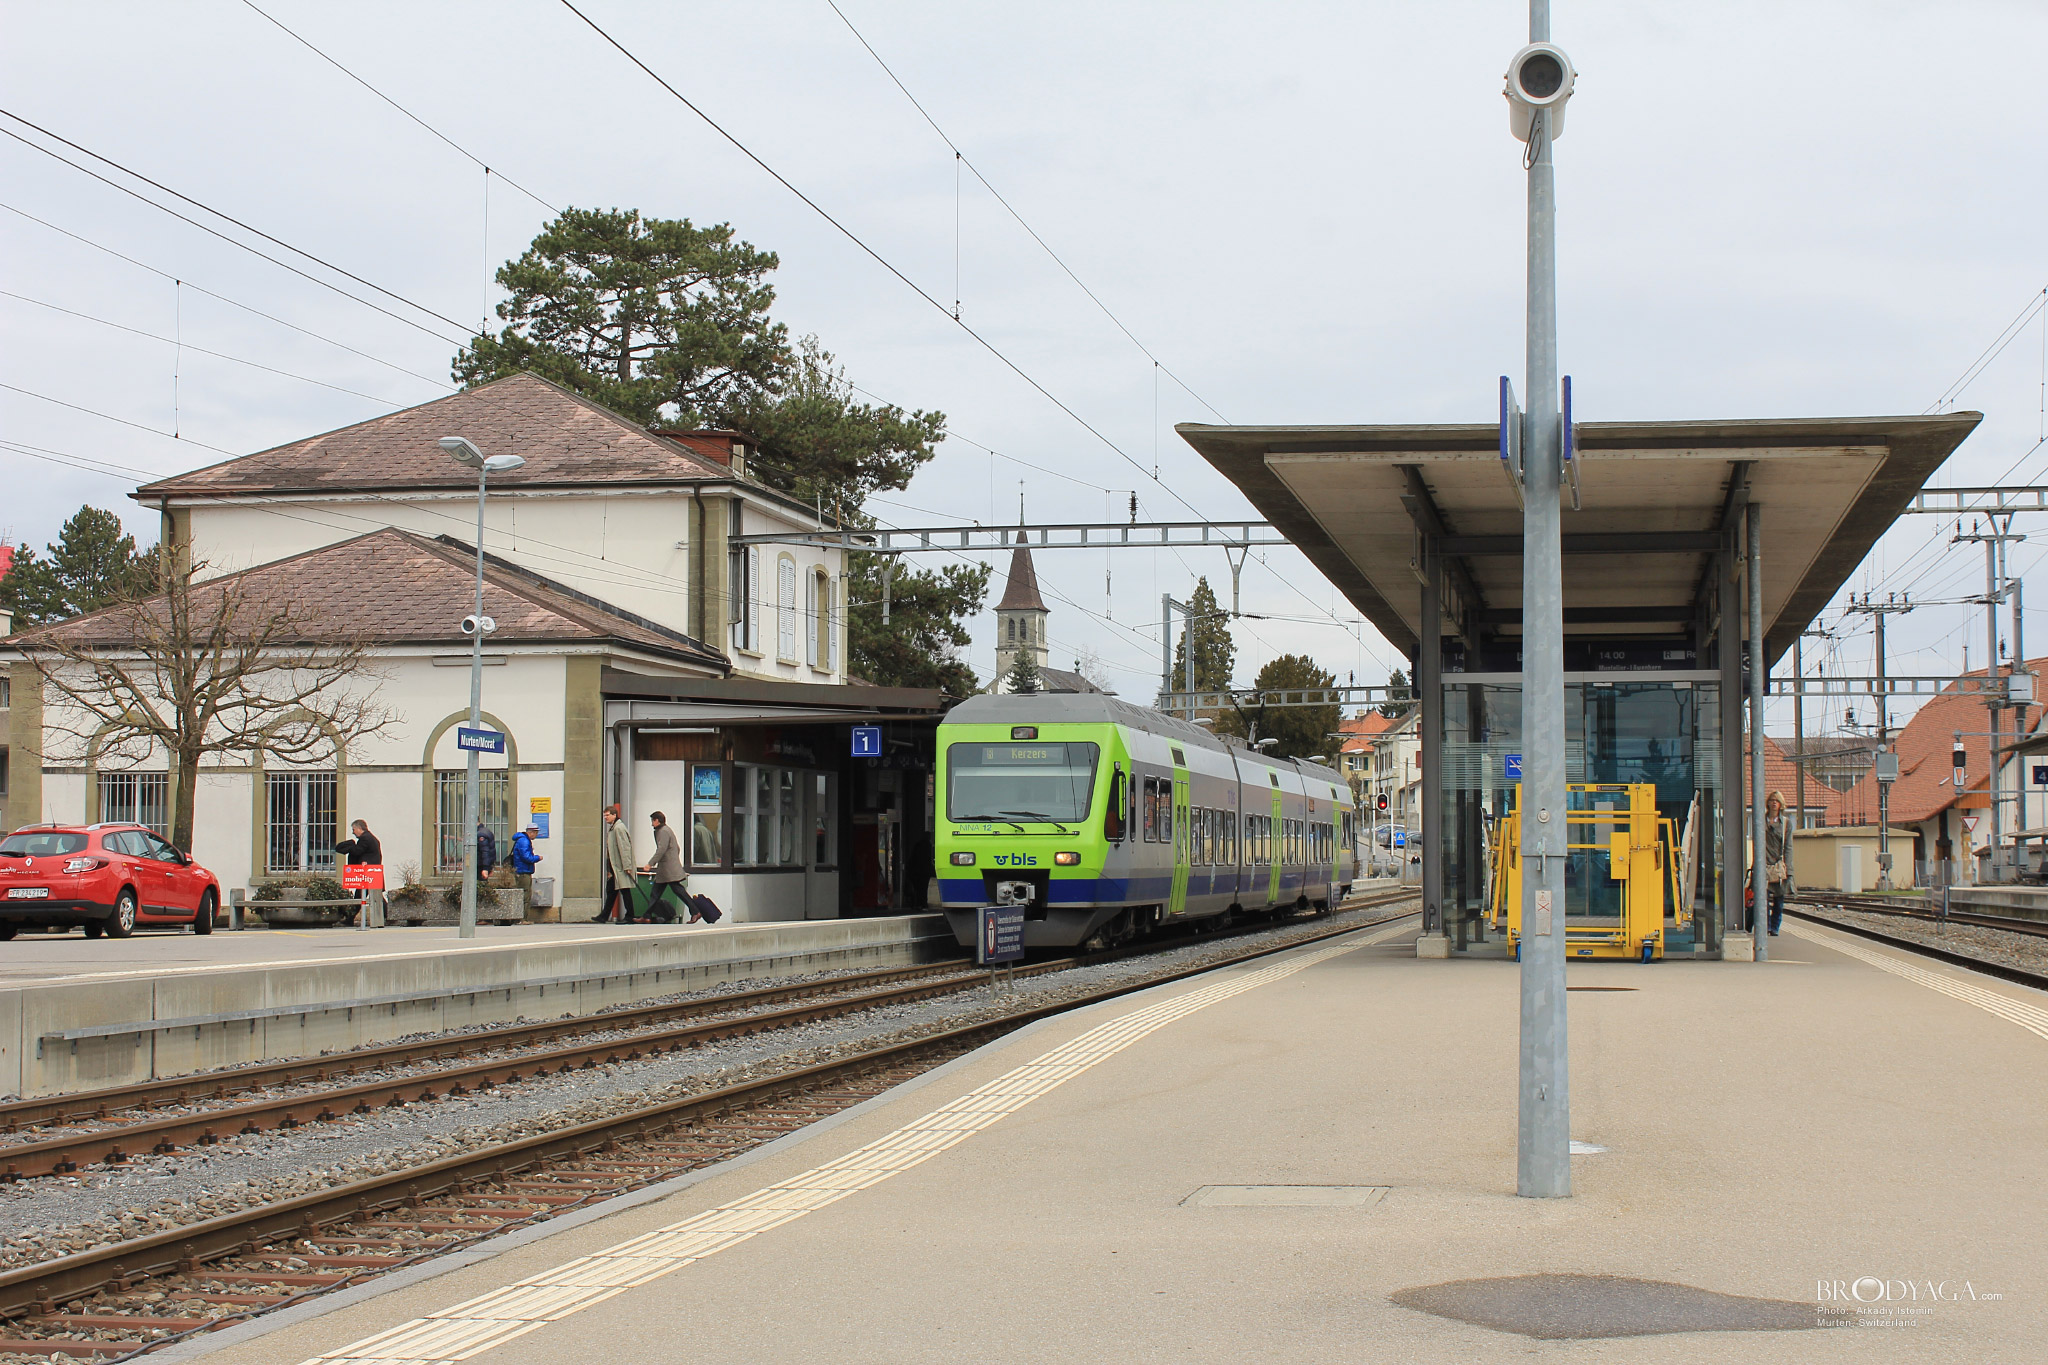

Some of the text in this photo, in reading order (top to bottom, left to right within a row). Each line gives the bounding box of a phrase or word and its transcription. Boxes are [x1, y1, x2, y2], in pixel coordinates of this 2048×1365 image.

[461, 735, 495, 749] Murten/Morat
[862, 736, 869, 751] 1
[1011, 747, 1047, 759] Kerzers
[982, 824, 992, 832] 12
[1011, 852, 1037, 866] bls
[345, 873, 374, 884] mobility
